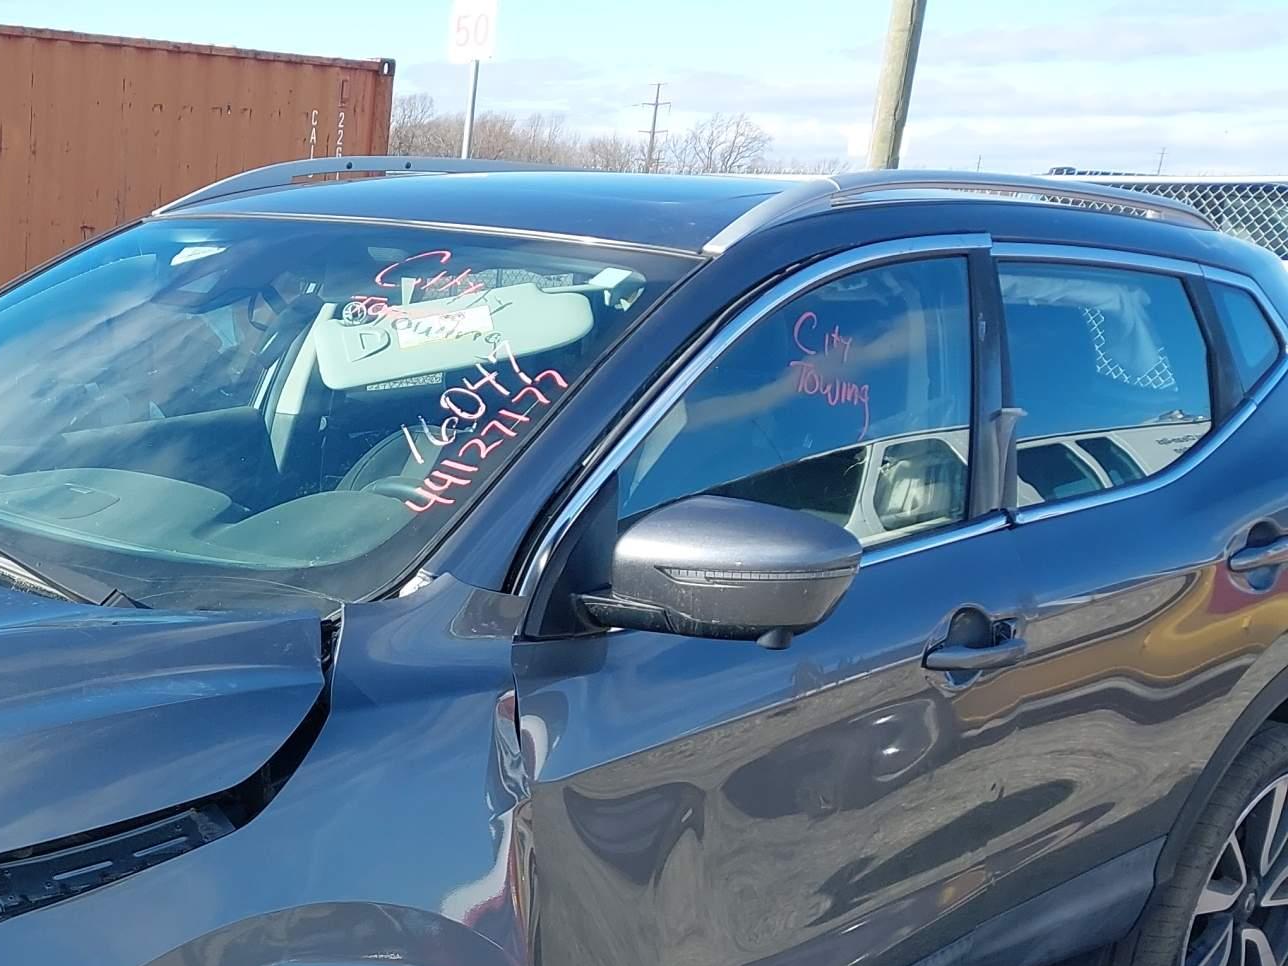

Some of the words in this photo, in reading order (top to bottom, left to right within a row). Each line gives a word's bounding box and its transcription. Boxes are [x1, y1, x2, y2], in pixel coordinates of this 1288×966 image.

[455, 14, 489, 47] 50
[308, 109, 319, 178] CAI
[793, 311, 853, 363] City
[400, 340, 533, 464] 16047
[788, 360, 870, 442] Towing
[404, 369, 569, 512] 44127177
